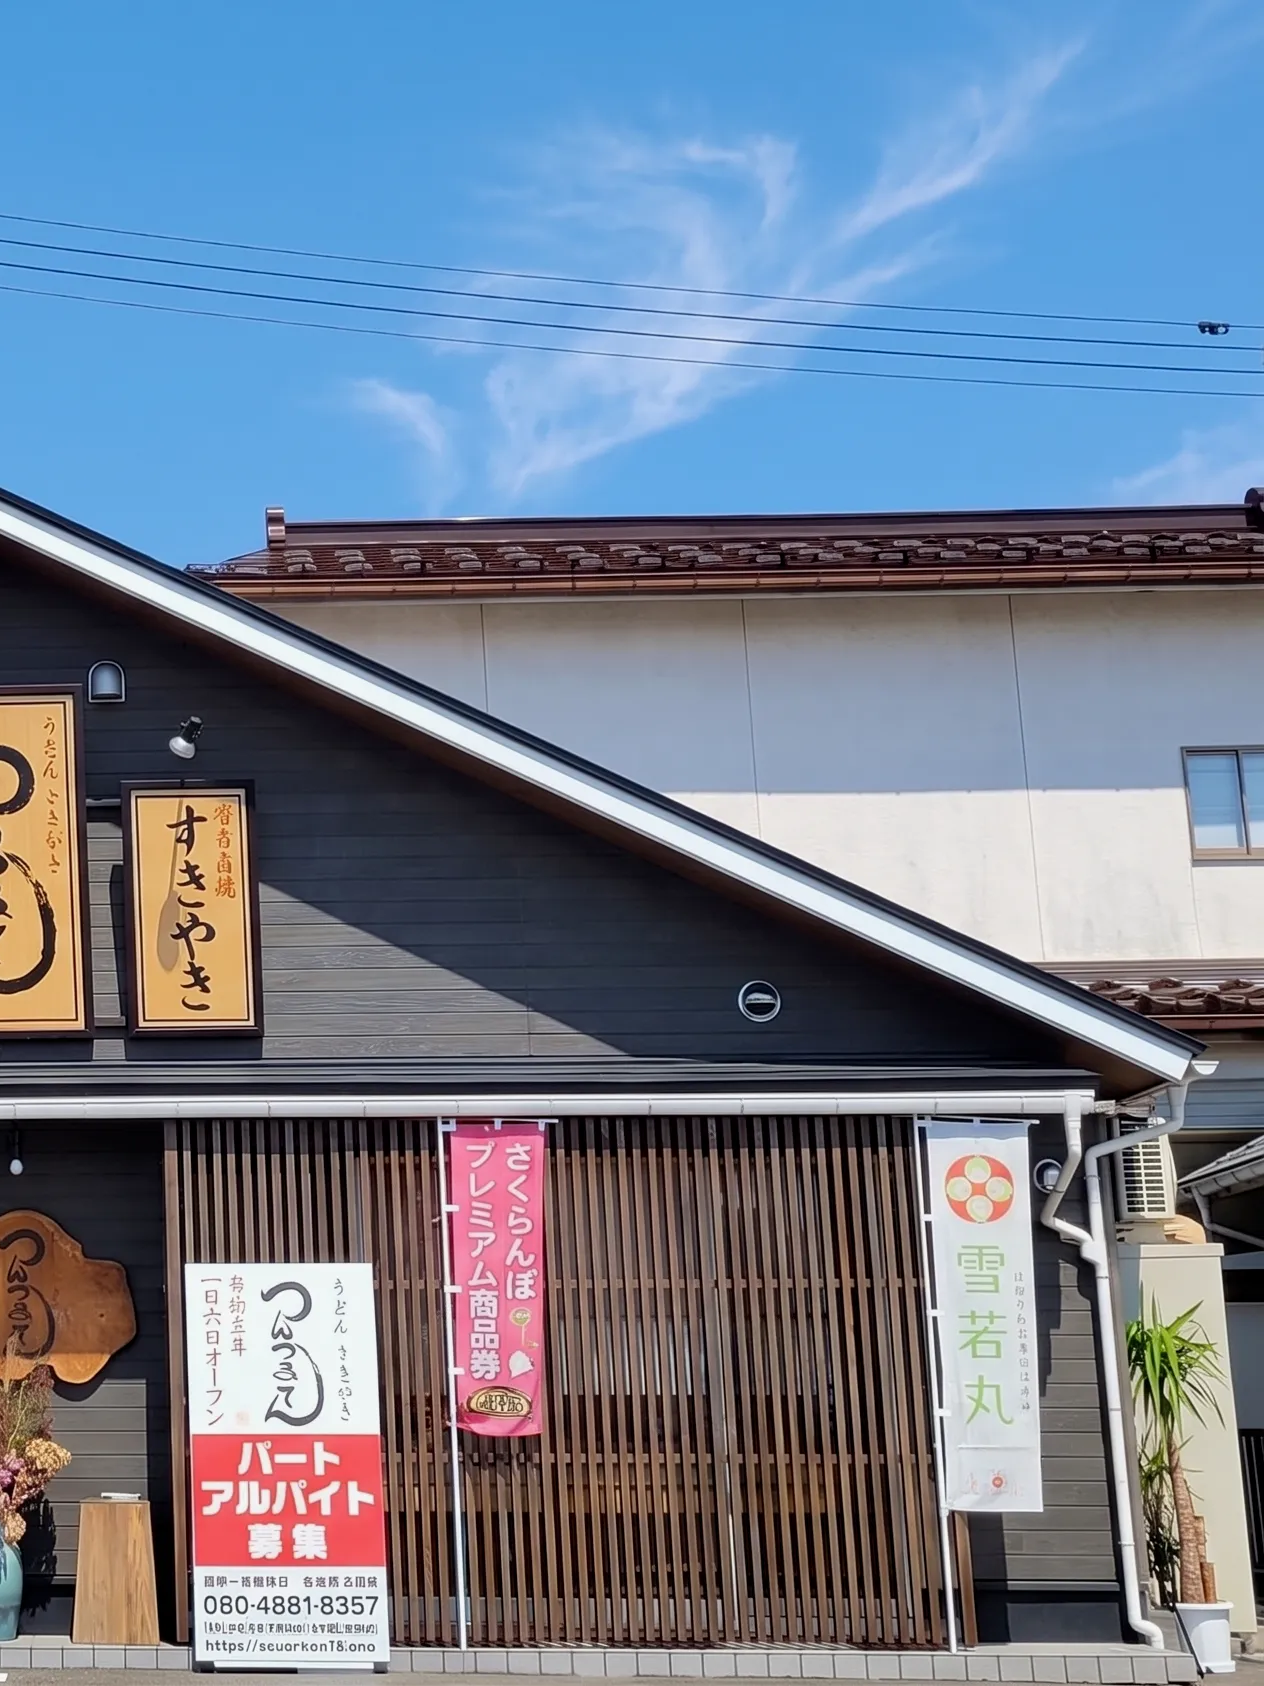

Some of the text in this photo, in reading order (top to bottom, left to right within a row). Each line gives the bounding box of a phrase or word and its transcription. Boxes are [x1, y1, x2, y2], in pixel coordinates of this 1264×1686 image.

[166, 804, 216, 1011] すきやき
[466, 1140, 500, 1380] プレミアム商品券
[505, 1142, 538, 1300] さくらんぼ
[957, 1245, 1014, 1425] 雪若丸
[238, 1440, 340, 1476] パート
[203, 1595, 379, 1616] 080-4881-8357
[247, 1523, 328, 1560] 募集
